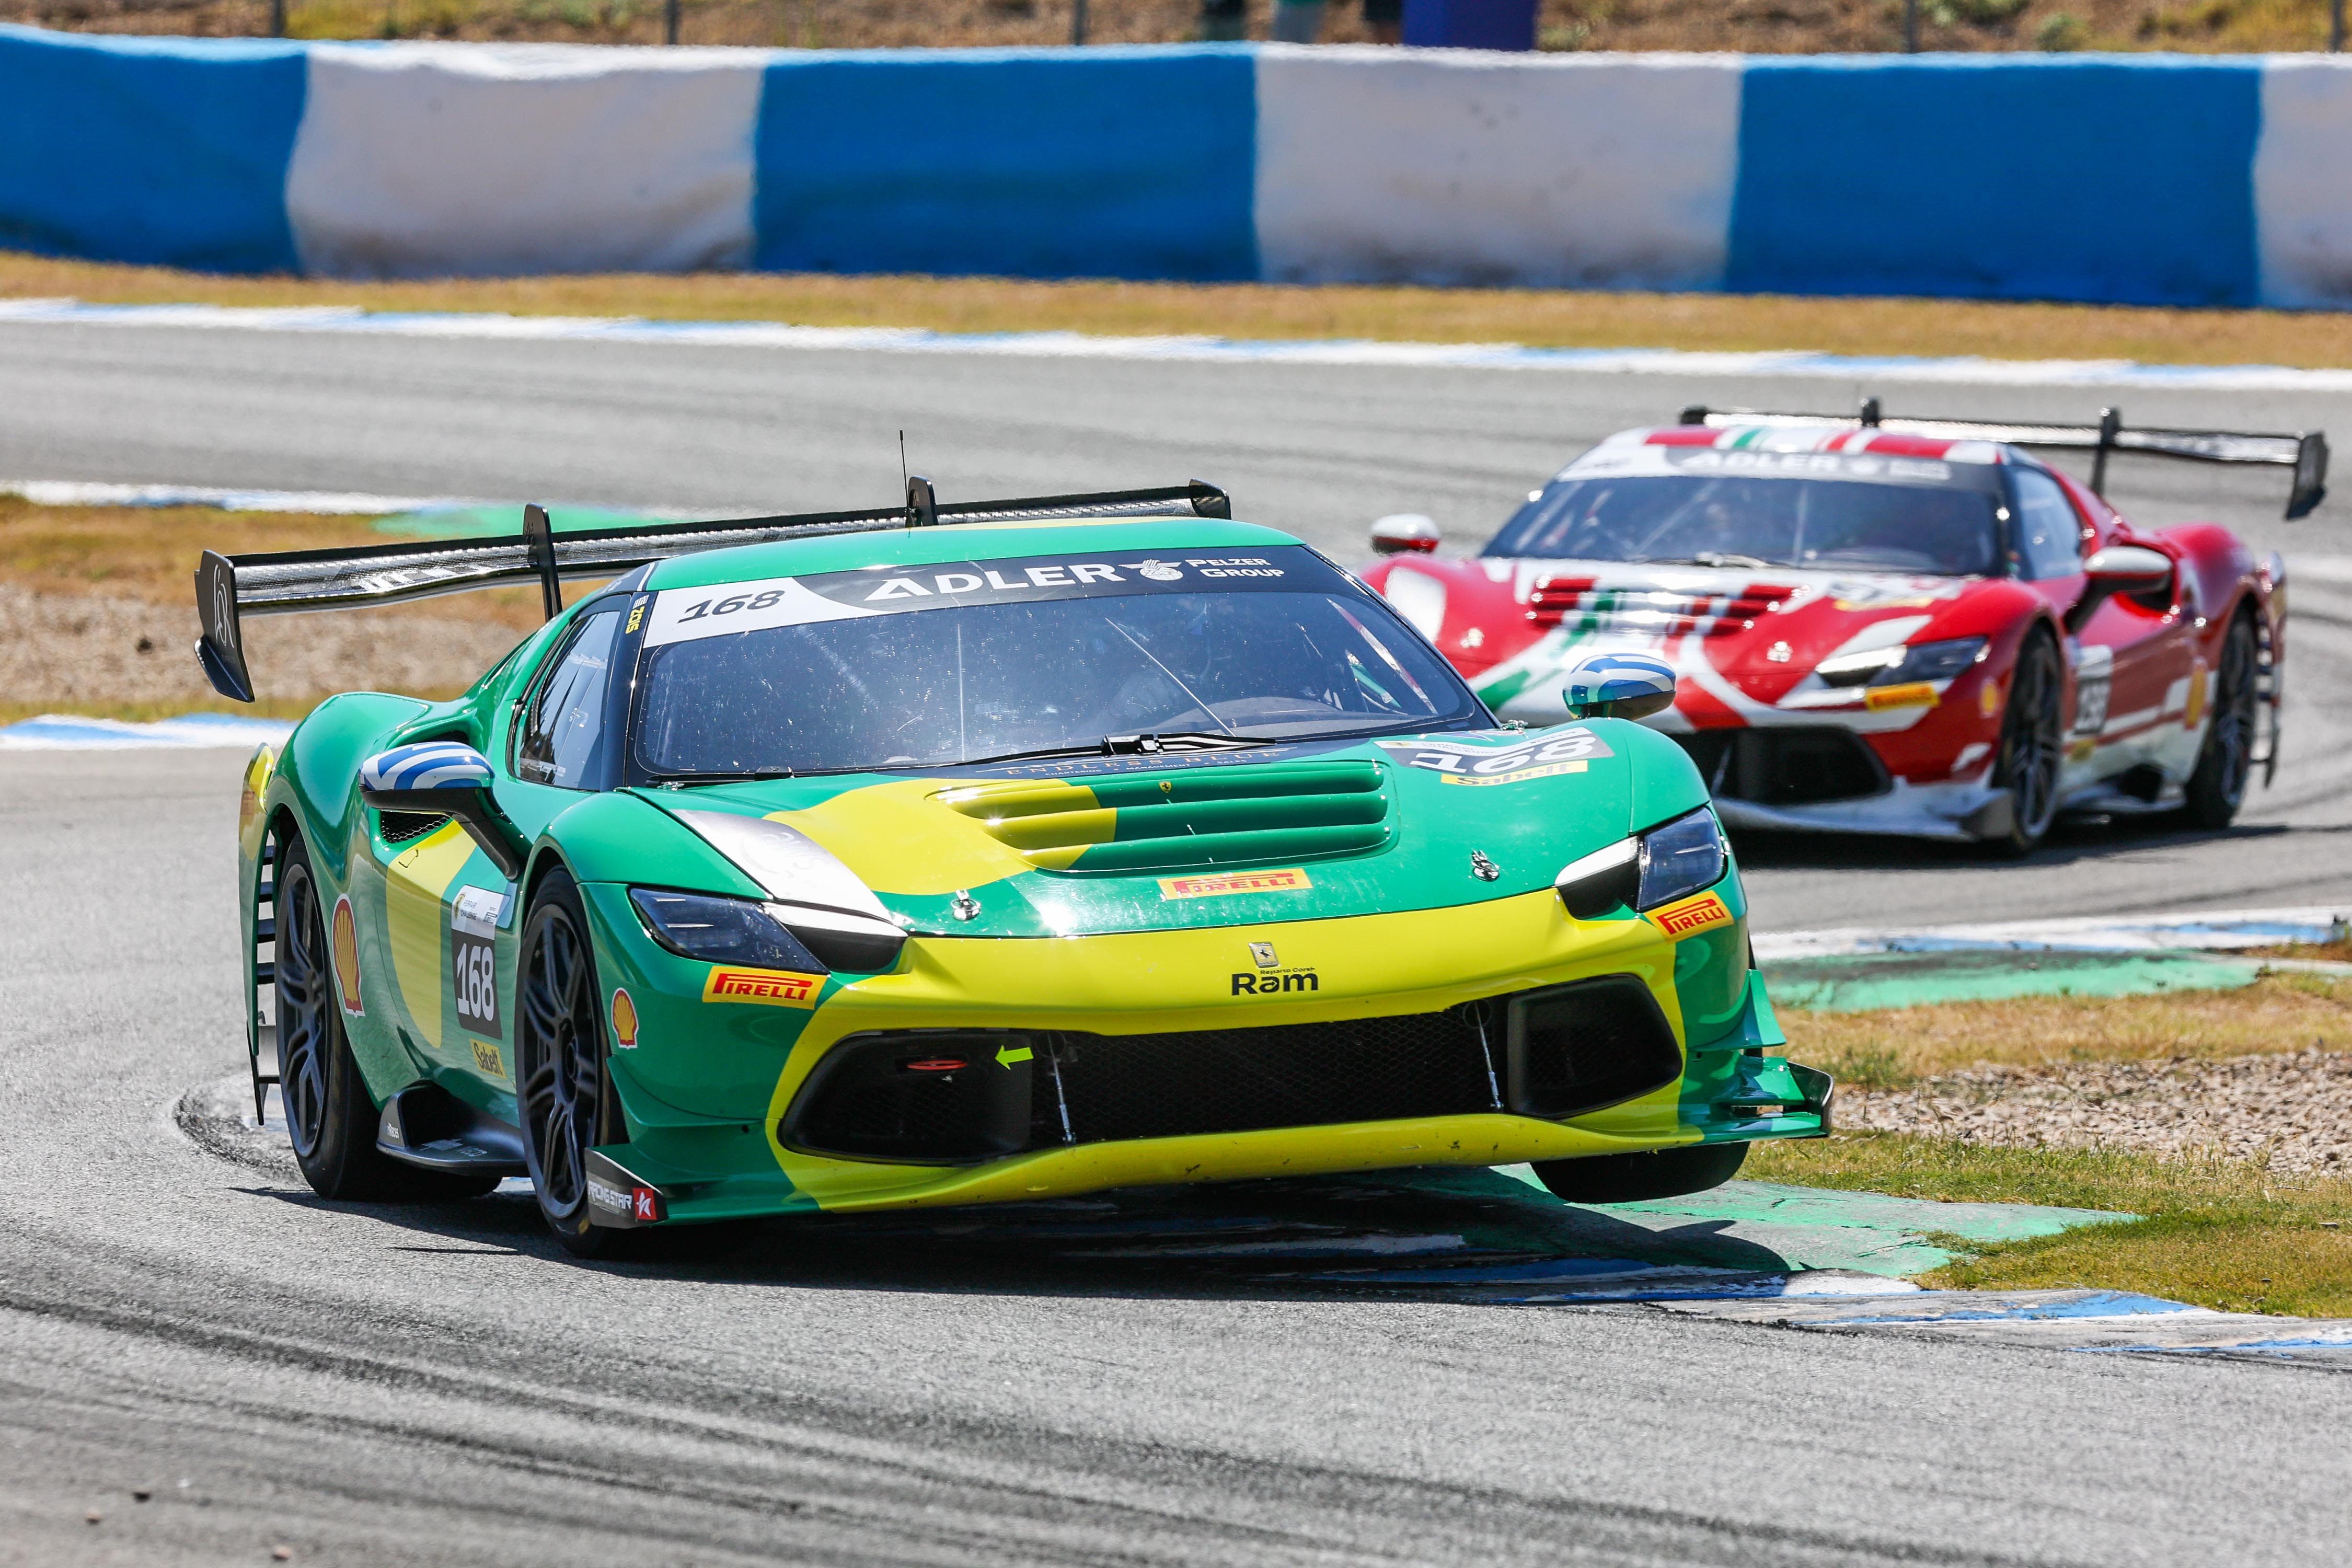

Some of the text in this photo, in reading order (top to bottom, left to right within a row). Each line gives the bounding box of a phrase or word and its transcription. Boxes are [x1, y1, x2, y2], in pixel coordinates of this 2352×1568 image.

[1185, 558, 1272, 567] PELZER
[1200, 569, 1285, 578] GROUP
[863, 563, 1127, 601] ADLER
[677, 590, 786, 624] 168
[1007, 752, 1280, 775] ENDLESS BLUE
[1410, 736, 1596, 774] 168
[1456, 763, 1573, 786] Sabelt
[1172, 872, 1296, 894] PIRELLI
[1656, 898, 1726, 935] PIRELLI
[457, 942, 494, 1021] 168
[712, 973, 813, 1000] PIRELLI
[1231, 973, 1319, 996] Ram
[474, 1042, 503, 1076] Sabelt
